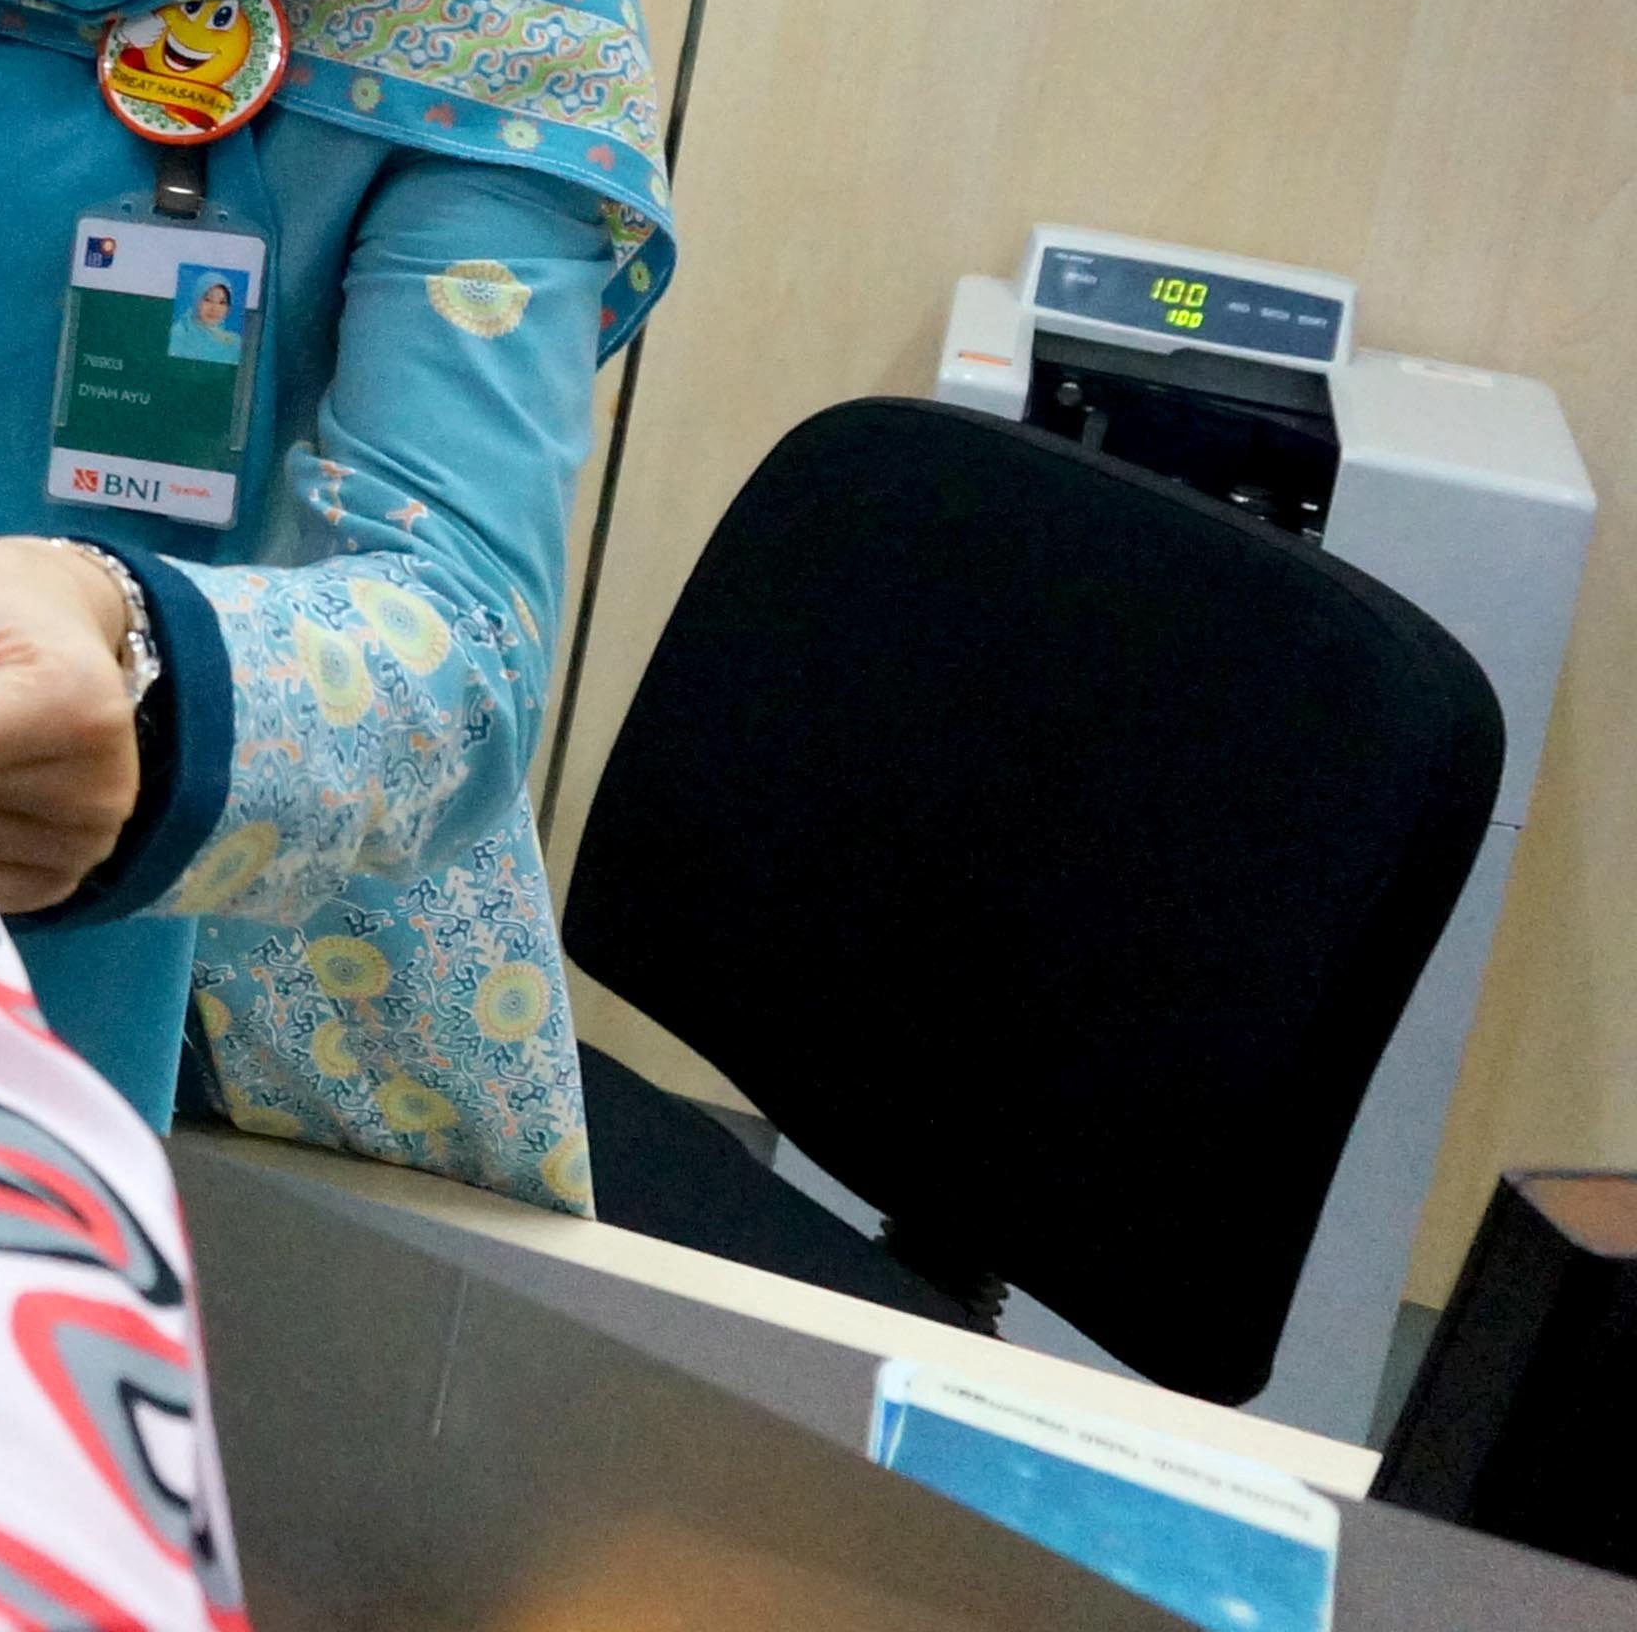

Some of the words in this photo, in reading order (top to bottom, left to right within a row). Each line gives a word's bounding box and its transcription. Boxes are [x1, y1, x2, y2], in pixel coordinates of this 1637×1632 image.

[1150, 277, 1208, 307] 100
[1165, 309, 1204, 328] 100
[78, 382, 118, 400] DYAH
[120, 389, 152, 405] AYU
[104, 473, 160, 502] BNI
